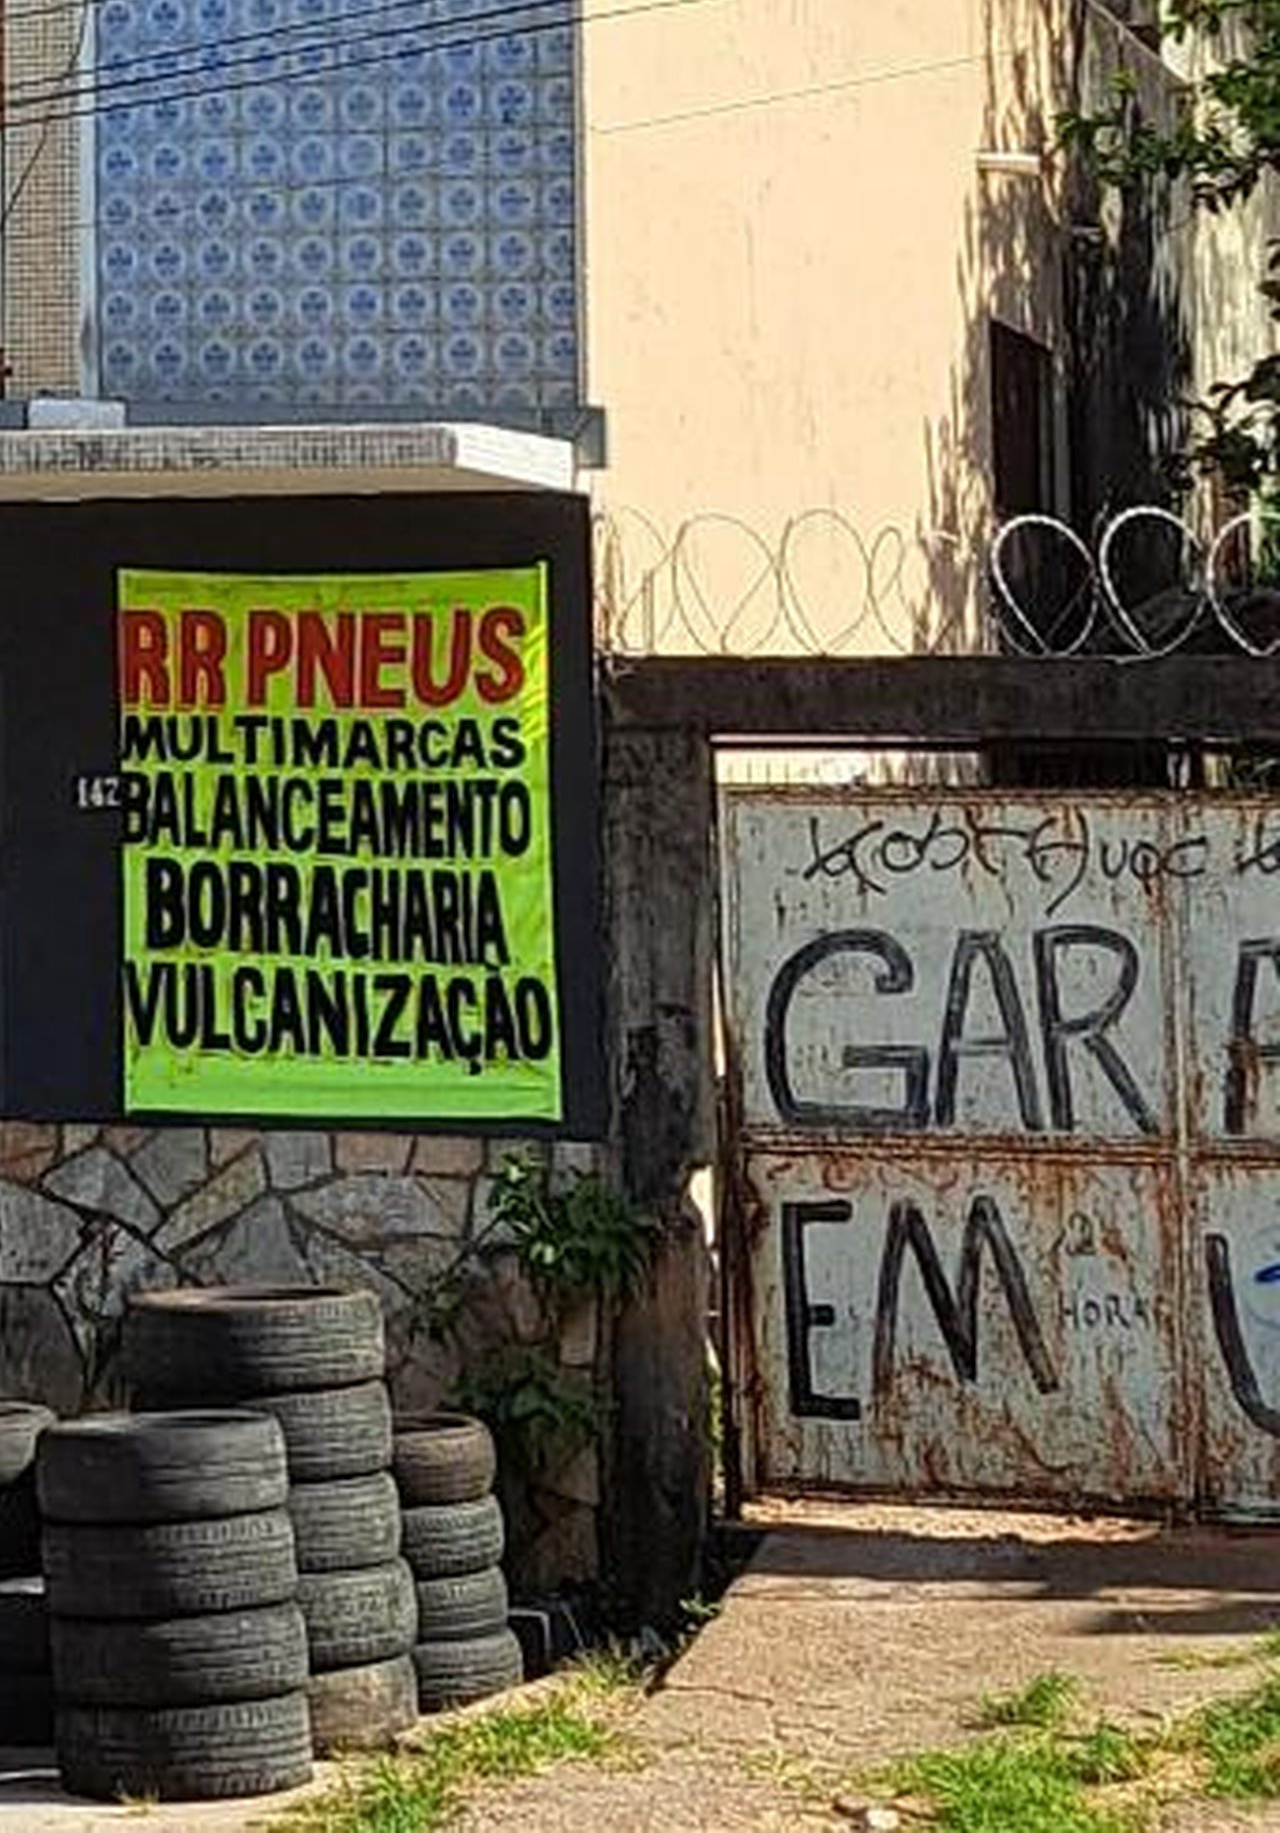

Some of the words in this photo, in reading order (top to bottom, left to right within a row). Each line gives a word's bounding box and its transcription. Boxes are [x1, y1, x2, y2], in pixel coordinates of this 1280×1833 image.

[121, 609, 228, 706] RR
[246, 607, 526, 709] PNEUS
[120, 714, 527, 769] MULTIMARCAS
[120, 771, 532, 858] BALANCEAMENTO
[144, 856, 508, 966] BORRACHARIA
[780, 1194, 1060, 1422] EM
